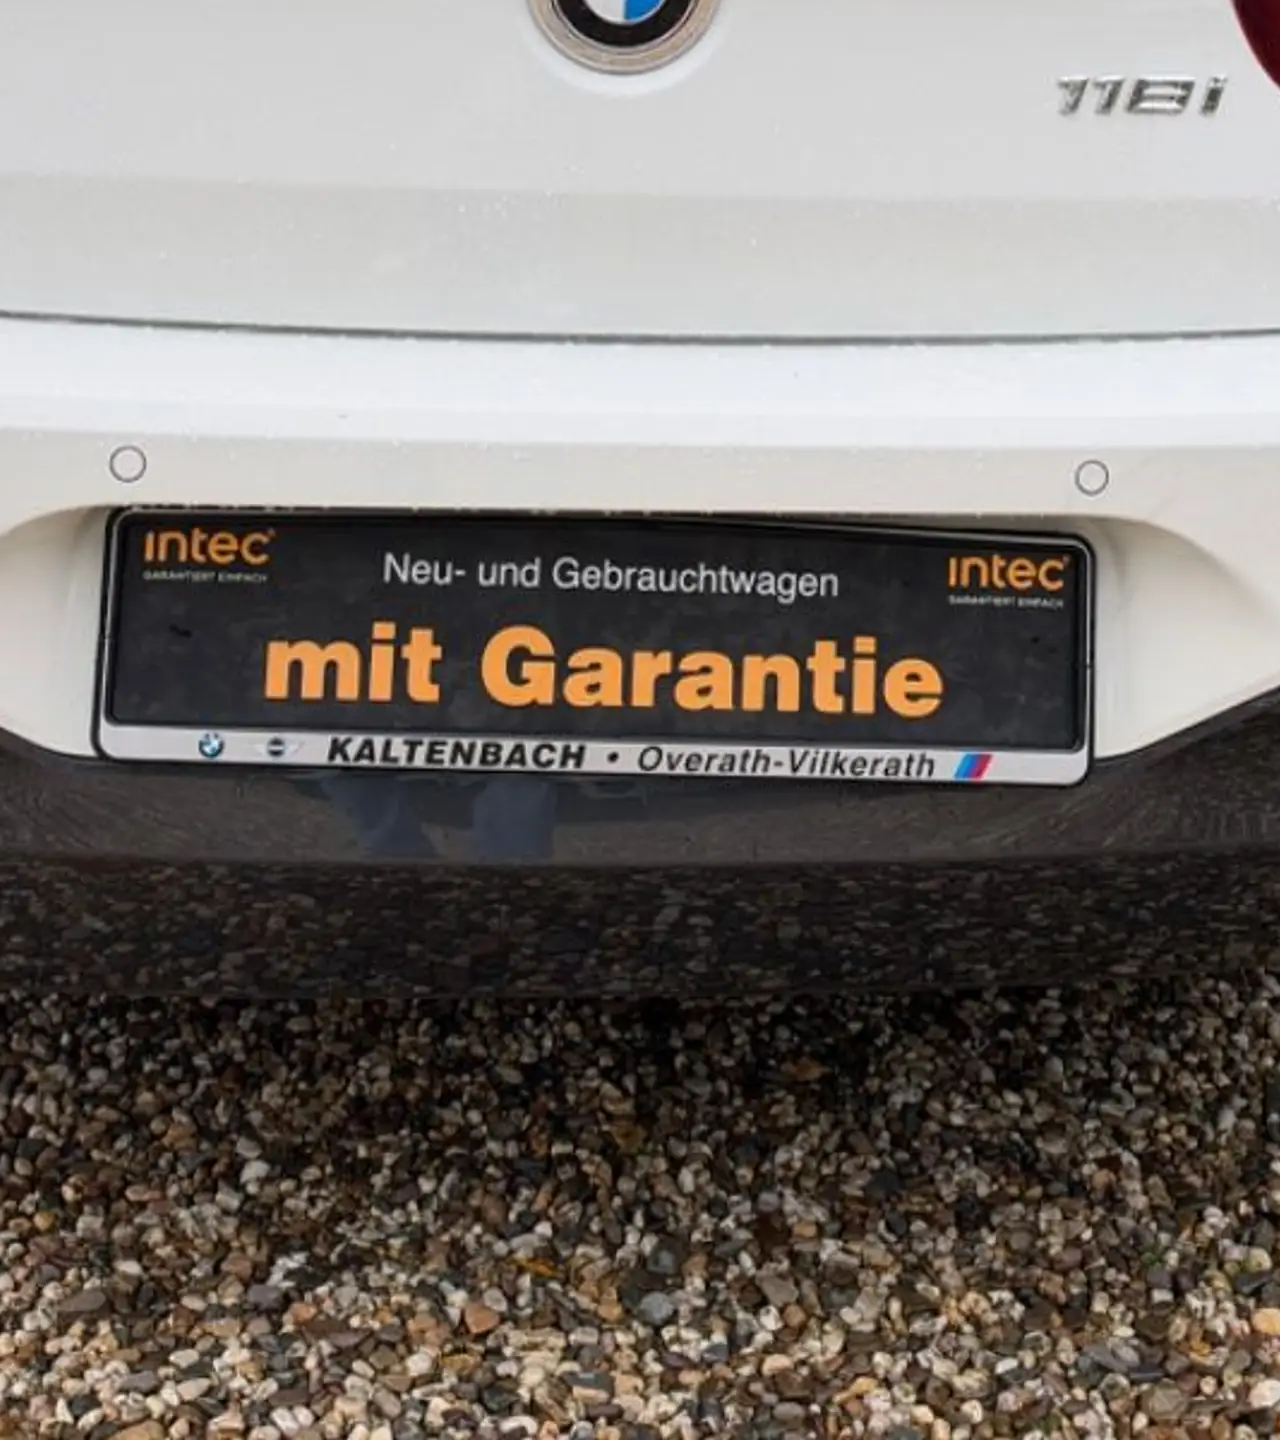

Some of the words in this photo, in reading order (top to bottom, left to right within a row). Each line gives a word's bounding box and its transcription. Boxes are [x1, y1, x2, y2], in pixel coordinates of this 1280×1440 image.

[1057, 76, 1228, 117] 118i
[143, 527, 272, 566] intec
[382, 552, 467, 586] Neu-
[477, 557, 542, 589] und
[551, 556, 840, 605] Gebrauchtwagen
[947, 554, 1065, 591] intec
[264, 621, 442, 704] mit
[479, 625, 944, 719] Garantie
[326, 736, 587, 769] KALTENBACH
[637, 745, 936, 778] Overath-Vilkerath
